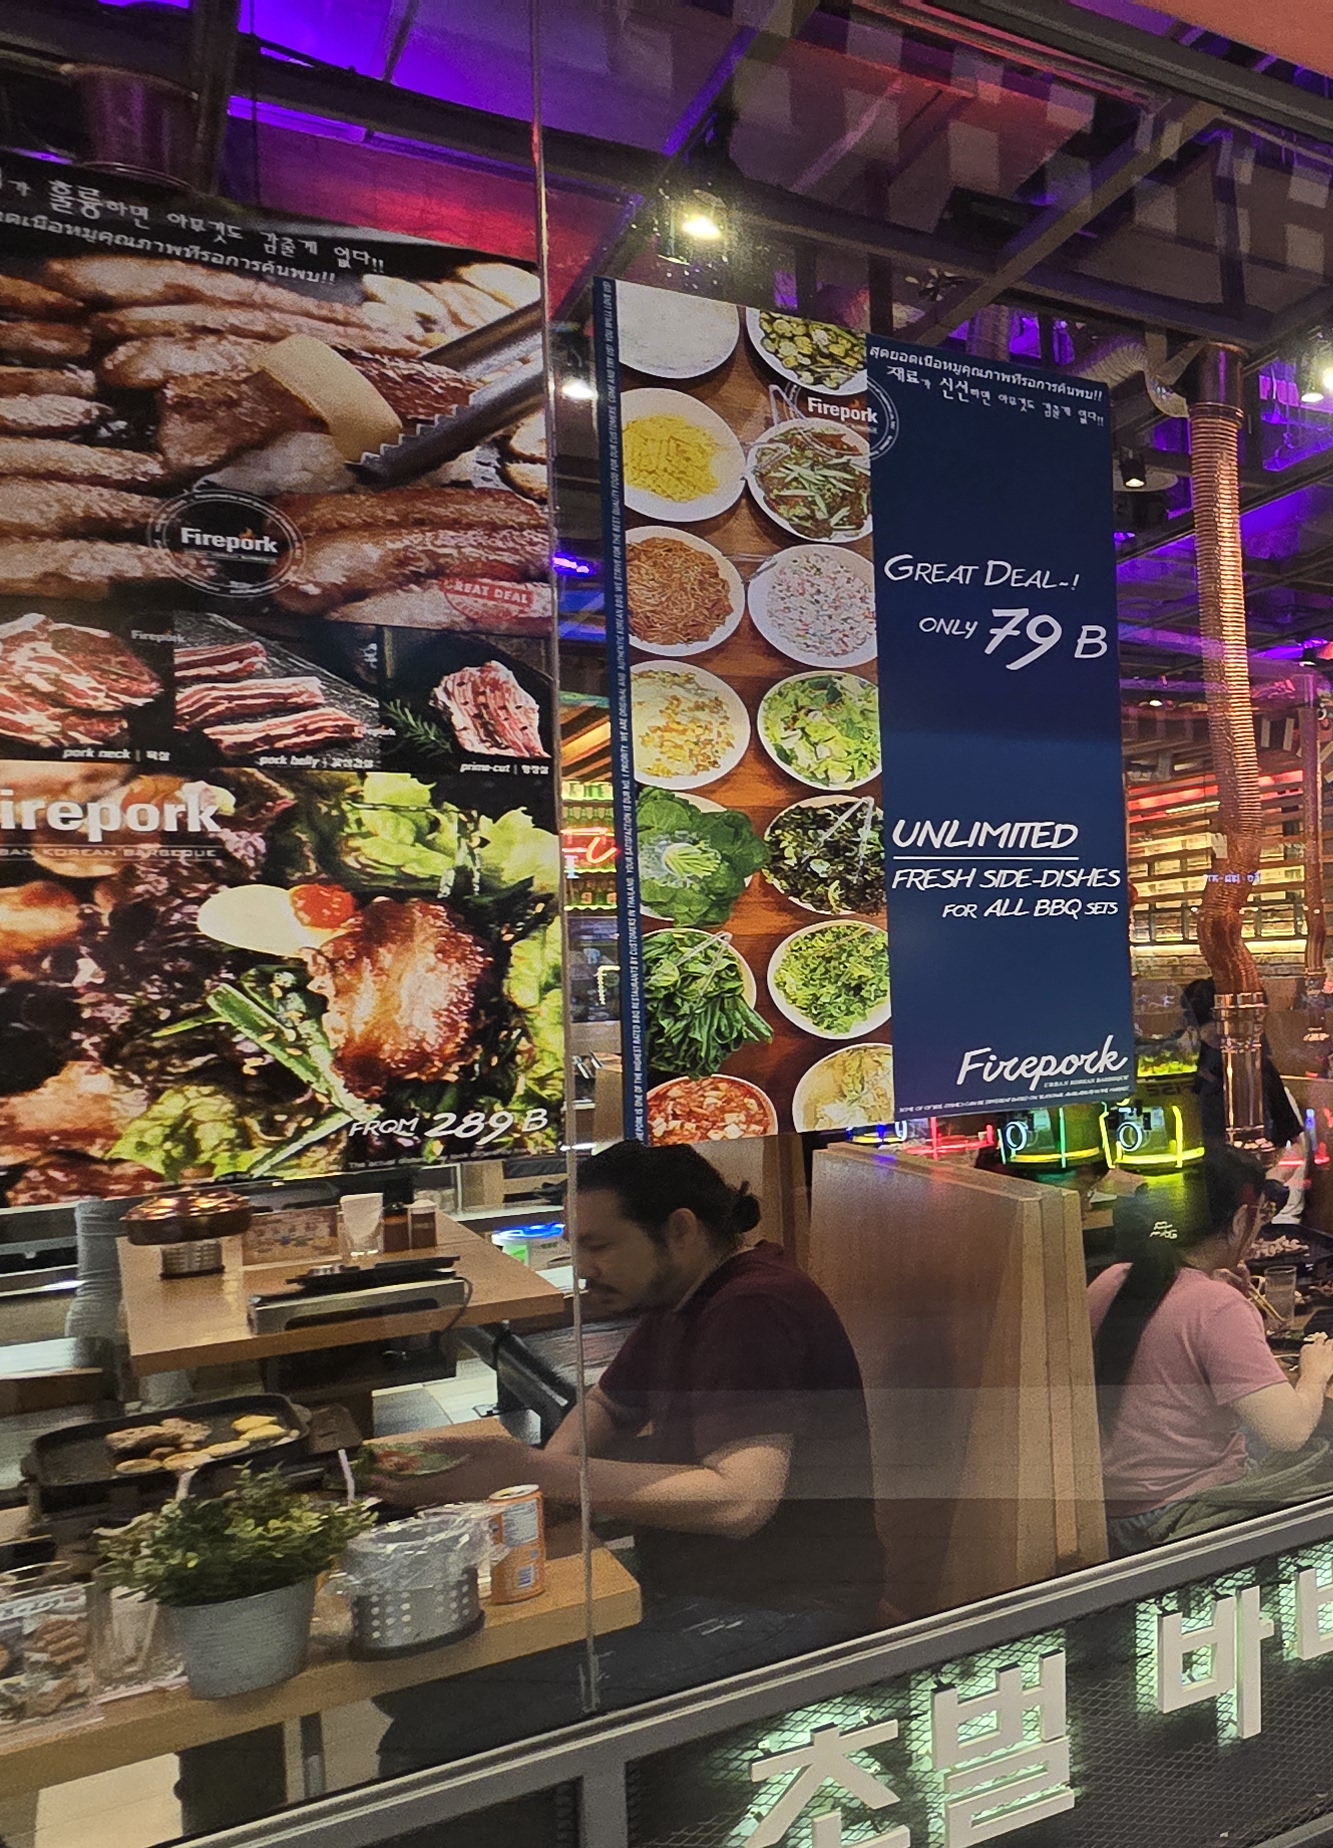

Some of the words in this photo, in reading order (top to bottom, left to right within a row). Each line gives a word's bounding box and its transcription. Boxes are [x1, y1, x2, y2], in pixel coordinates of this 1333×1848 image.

[49, 179, 150, 230] 훌륭하면
[167, 213, 243, 245] 아무것도
[806, 396, 879, 426] Firepork
[608, 445, 618, 458] OUR
[608, 458, 618, 471] FOR
[610, 473, 619, 489] FOOD
[611, 490, 620, 516] QUALITY
[611, 516, 620, 532] BEST
[180, 526, 278, 554] Firepork
[612, 533, 621, 545] THE
[612, 546, 621, 558] FOR
[613, 559, 622, 580] STRIVE
[883, 554, 979, 587] GREAT
[492, 587, 530, 605] DEAL
[615, 609, 624, 634] KOREAN
[918, 616, 978, 640] ONLY
[984, 608, 1063, 670] 79
[1075, 625, 1109, 660] B
[616, 635, 625, 670] AUTHENTIC
[618, 688, 628, 717] ORIGINAL
[619, 718, 628, 730] ARE
[619, 731, 629, 742] WE
[63, 748, 94, 761] pork
[622, 791, 631, 804] OUR
[0, 790, 220, 843] irepork
[622, 812, 633, 856] SATISFACTION
[892, 819, 1079, 851] UNLIMITED
[0, 846, 35, 858] BAN
[43, 847, 117, 858] KOREAN
[123, 847, 217, 858] BARBEQUE
[892, 869, 974, 890] FRESH
[978, 869, 1122, 889] SIDE-DISHES
[942, 903, 978, 920] FOR
[983, 900, 1029, 918] ALL
[1034, 900, 1082, 920] BBQ
[1084, 901, 1119, 916] SETS
[627, 918, 638, 956] CUSTOMERS
[630, 966, 641, 1009] RESTAURANTS
[631, 1024, 642, 1044] RATED
[956, 1035, 1128, 1091] Firepork
[633, 1072, 643, 1084] THE
[349, 1117, 421, 1137] FROM
[424, 1111, 515, 1146] 289
[522, 1107, 548, 1133] B
